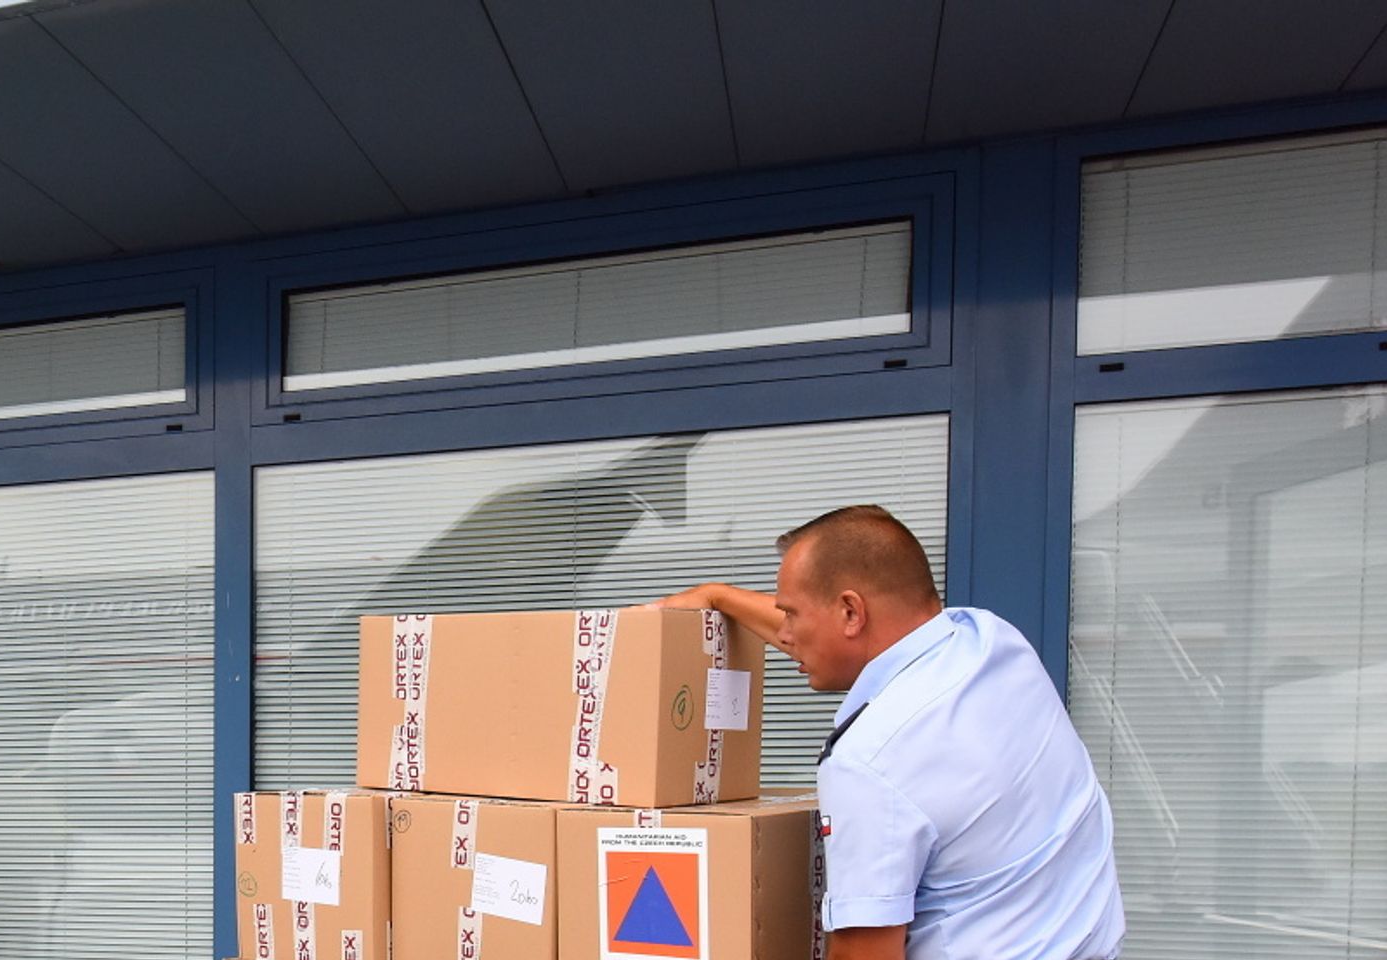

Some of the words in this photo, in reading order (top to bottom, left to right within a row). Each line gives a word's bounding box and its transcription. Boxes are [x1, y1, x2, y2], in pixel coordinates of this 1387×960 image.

[579, 611, 594, 646] OR
[396, 633, 407, 700] ORTEX
[576, 659, 591, 694] EX
[242, 794, 255, 844] RTEX
[455, 836, 469, 867] EX
[256, 903, 269, 959] ORTE
